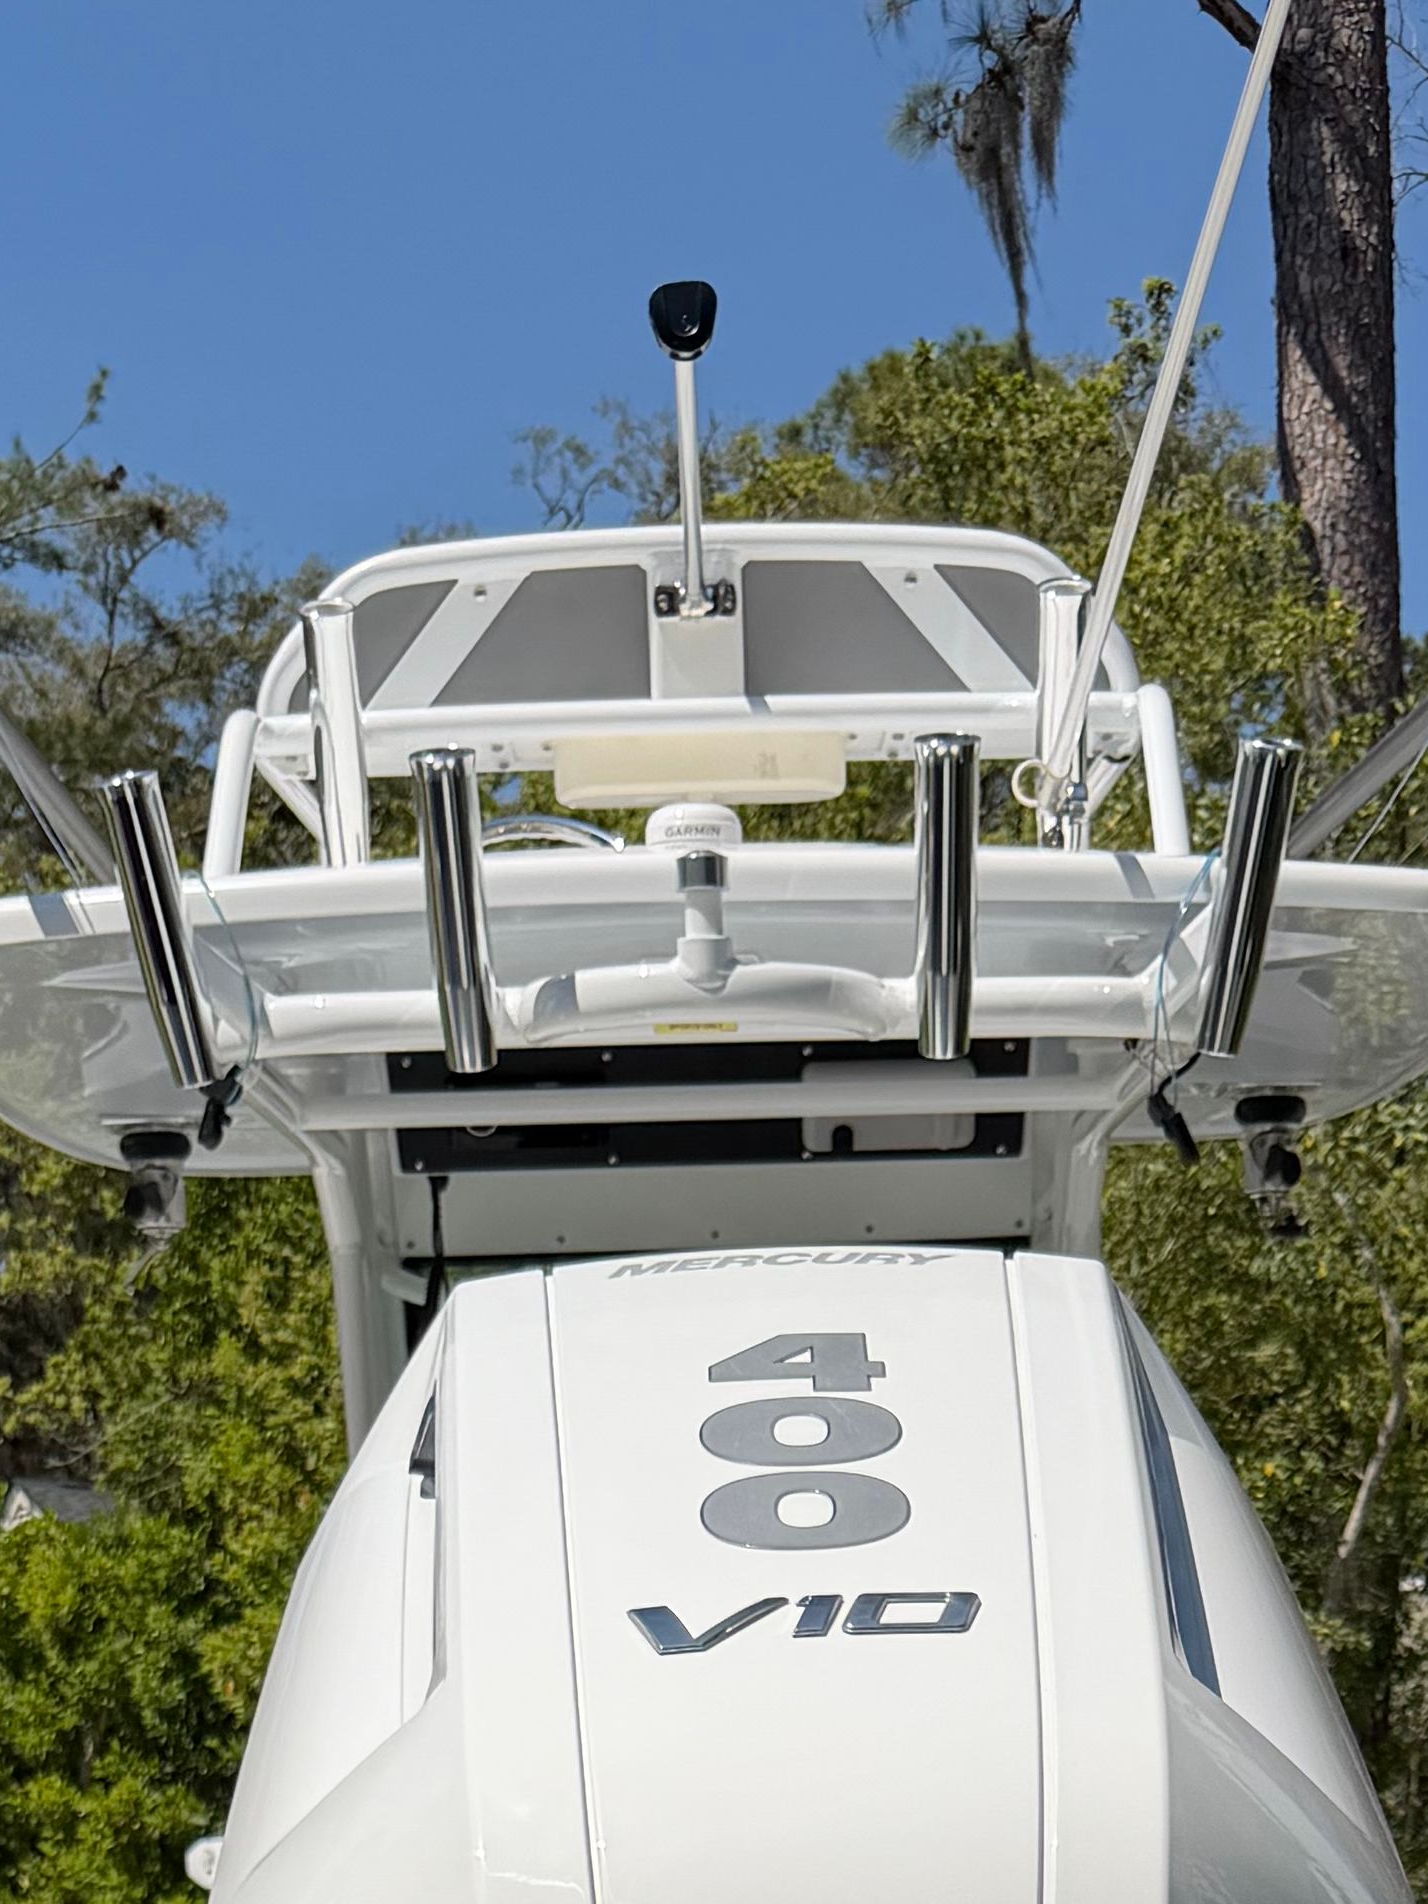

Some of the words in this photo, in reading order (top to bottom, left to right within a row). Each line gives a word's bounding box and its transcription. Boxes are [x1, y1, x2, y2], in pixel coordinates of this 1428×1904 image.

[664, 825, 721, 837] GARMIN
[608, 1251, 956, 1280] MERCURY
[699, 1332, 911, 1550] 400
[627, 1592, 982, 1655] V10
